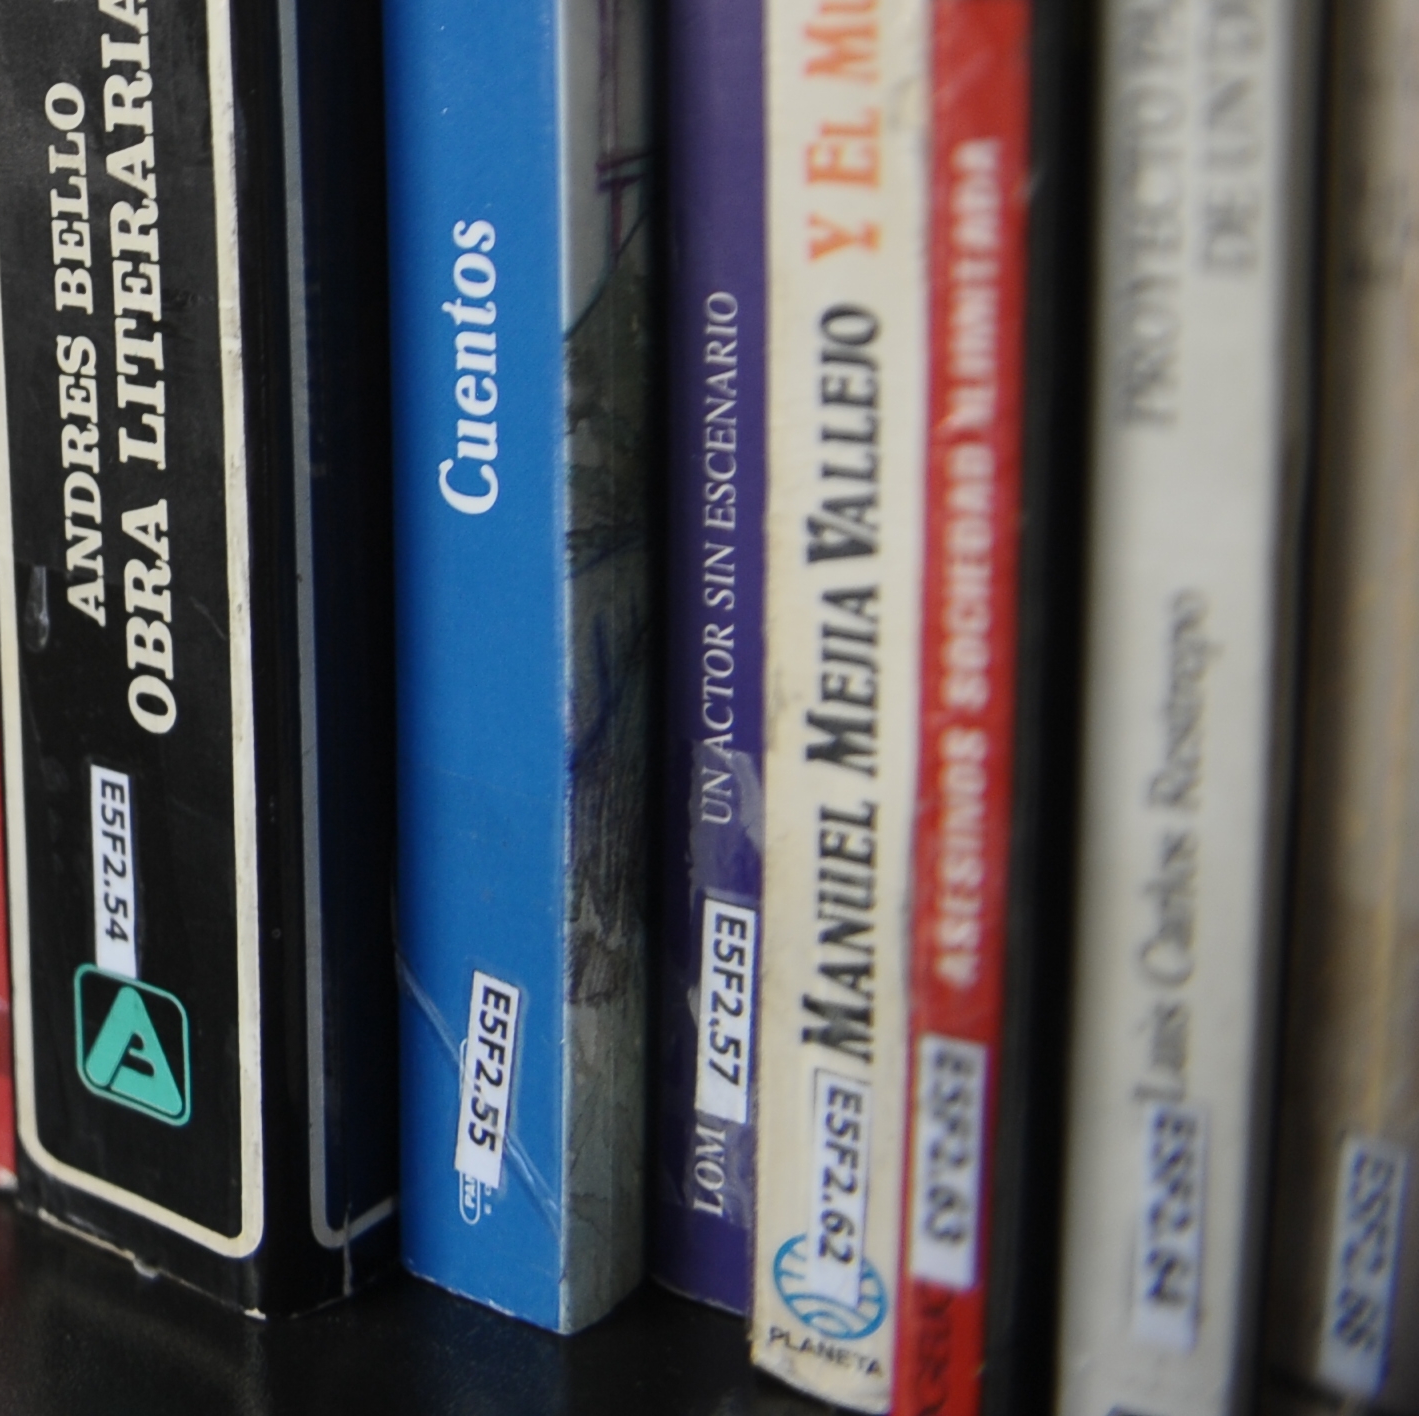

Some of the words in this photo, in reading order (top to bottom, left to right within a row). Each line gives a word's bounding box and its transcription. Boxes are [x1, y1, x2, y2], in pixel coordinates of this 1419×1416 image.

[44, 82, 94, 315] BELLO
[805, 121, 882, 190] EL
[809, 215, 882, 264] Y
[439, 219, 499, 515] Cuentos
[704, 290, 739, 532] ESCENARIO
[806, 301, 881, 566] VALLEJO
[54, 335, 106, 628] ANDRES
[120, 498, 177, 735] OBRA
[703, 542, 736, 611] SIN
[700, 622, 736, 758] ACTOR
[806, 585, 880, 777] MEJIA
[99, 777, 130, 944] E5F2.54
[700, 764, 733, 825] UN
[708, 912, 747, 1086] E5F2.57
[802, 802, 879, 1064] MANUEL
[469, 986, 511, 1154] E5F2.55
[819, 1086, 863, 1265] E5F2.62
[769, 1325, 885, 1379] PLANETA
